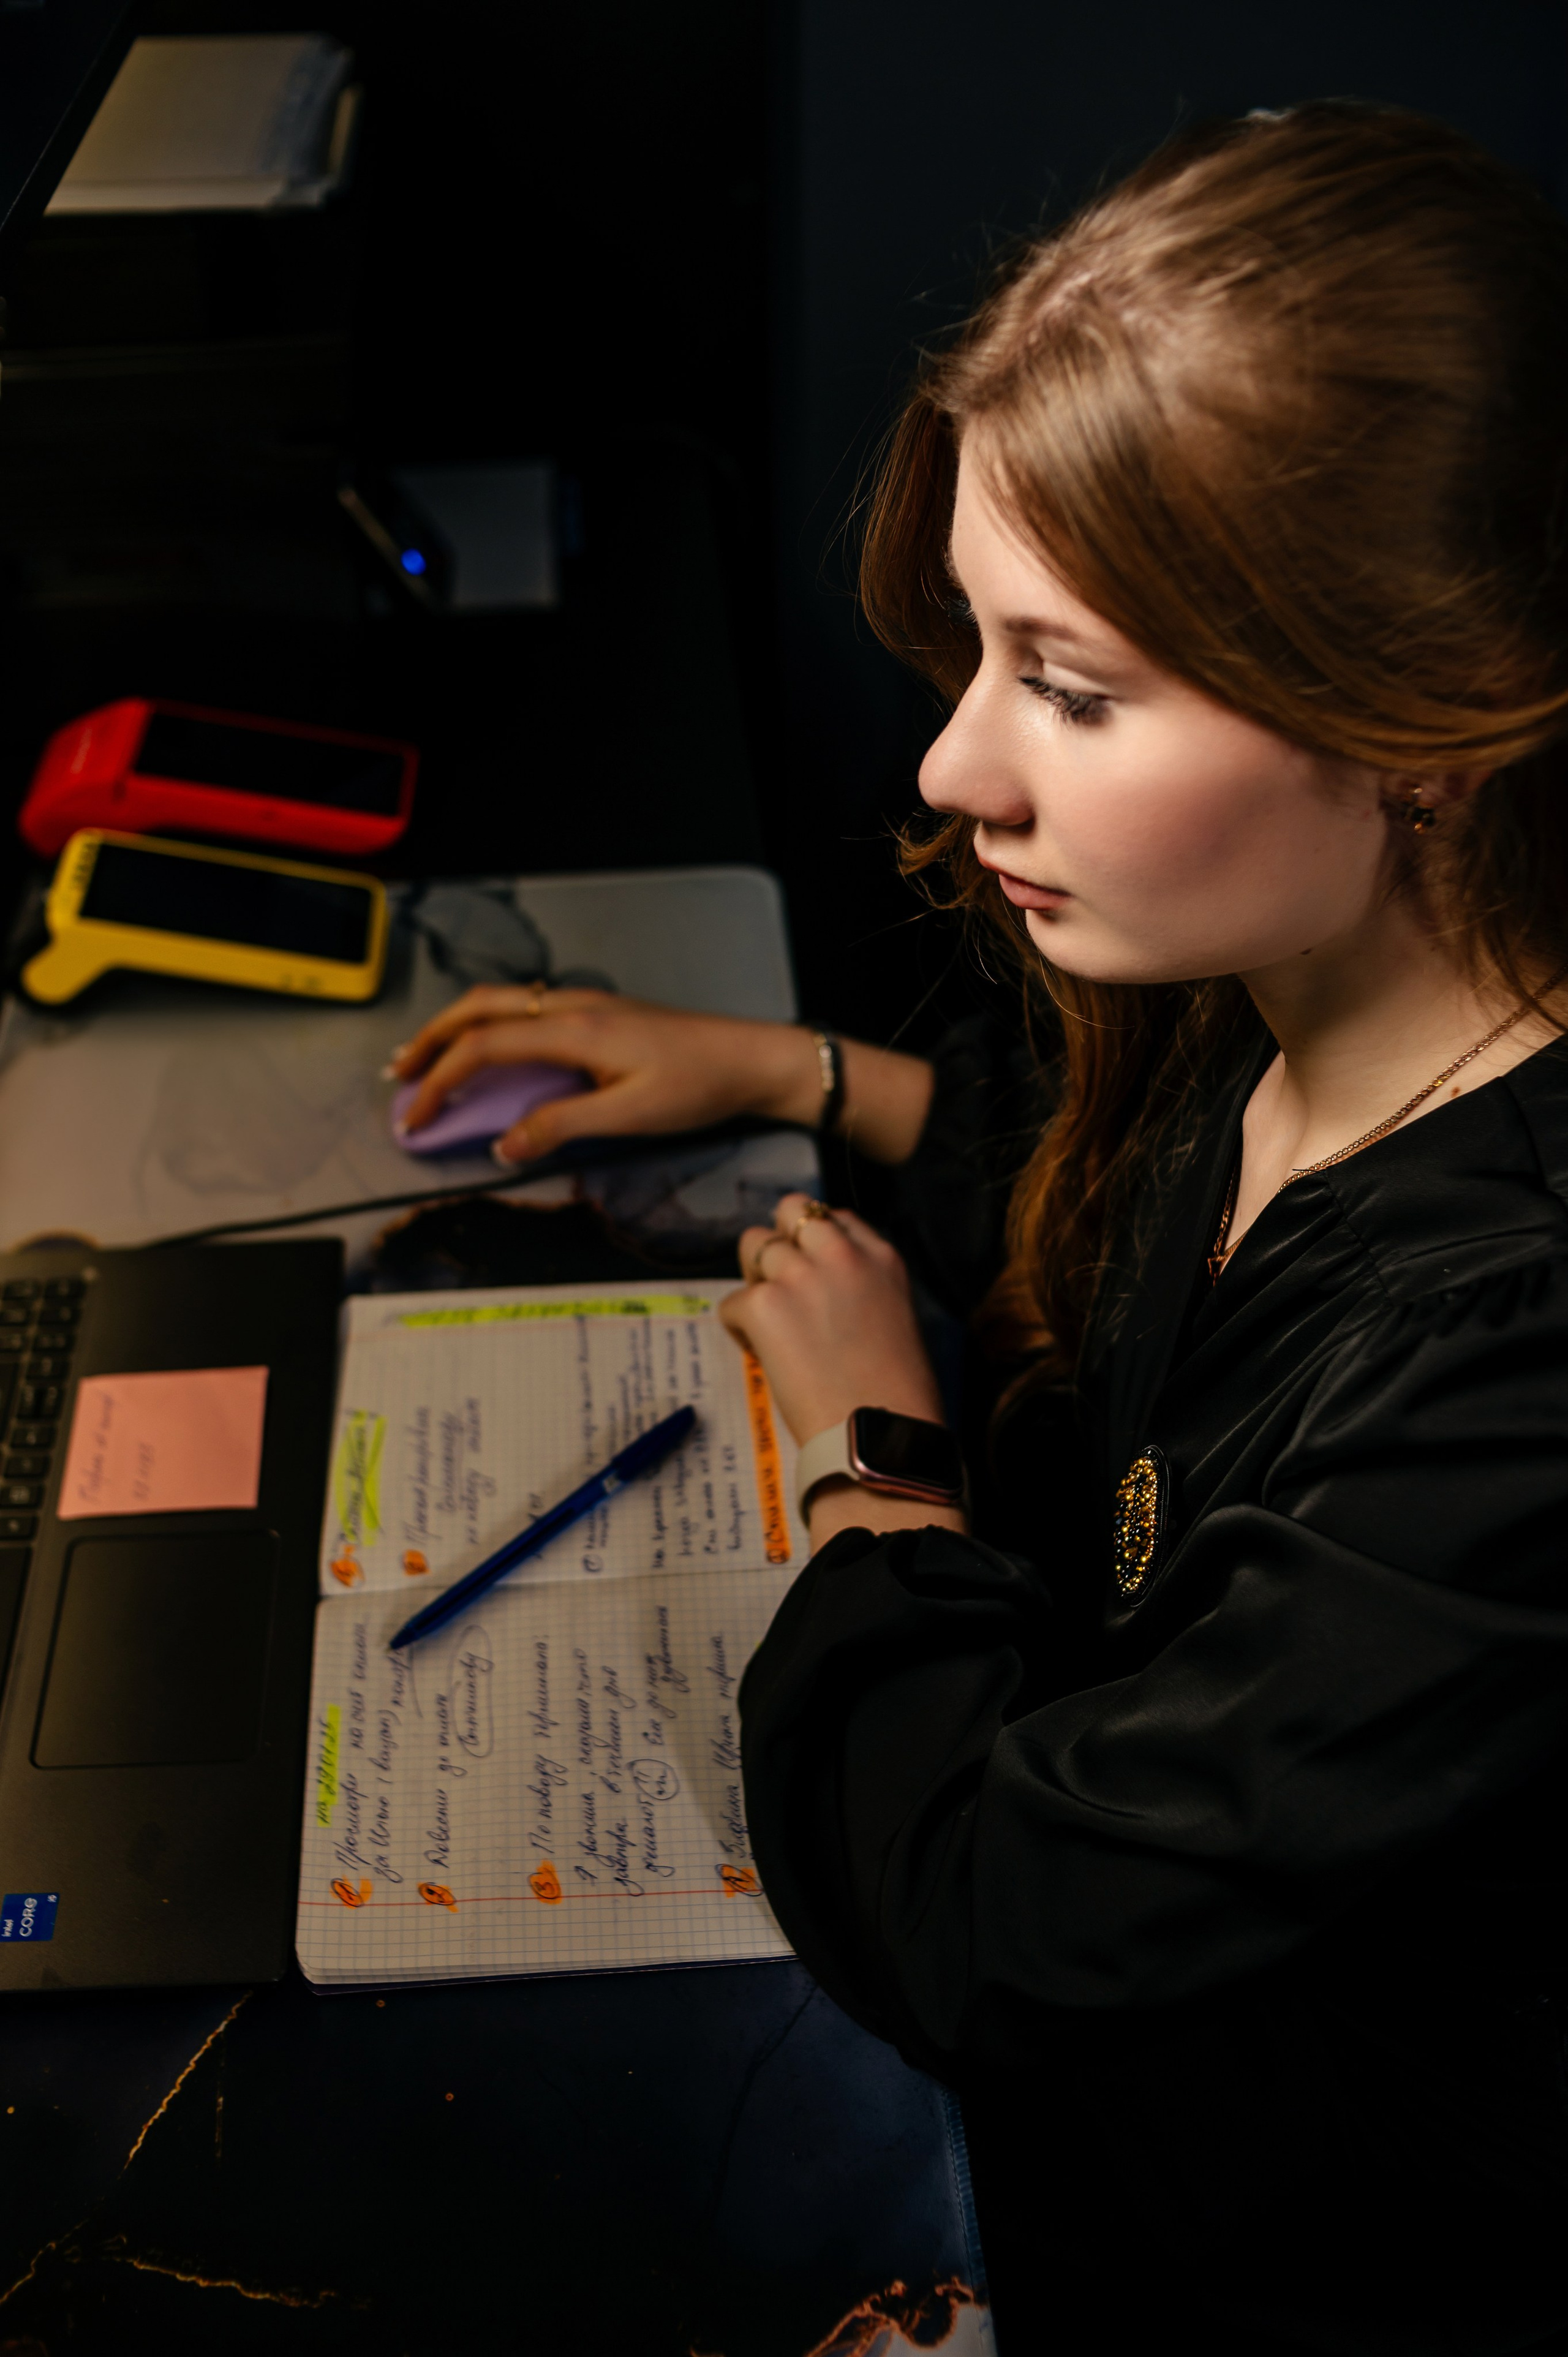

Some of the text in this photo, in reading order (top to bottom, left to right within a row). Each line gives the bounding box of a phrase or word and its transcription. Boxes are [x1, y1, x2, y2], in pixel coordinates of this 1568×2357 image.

[526, 1754, 568, 1818] поводу
[527, 1825, 555, 1853] По
[1, 1918, 14, 1937] intel
[19, 1897, 37, 1937] CORE
